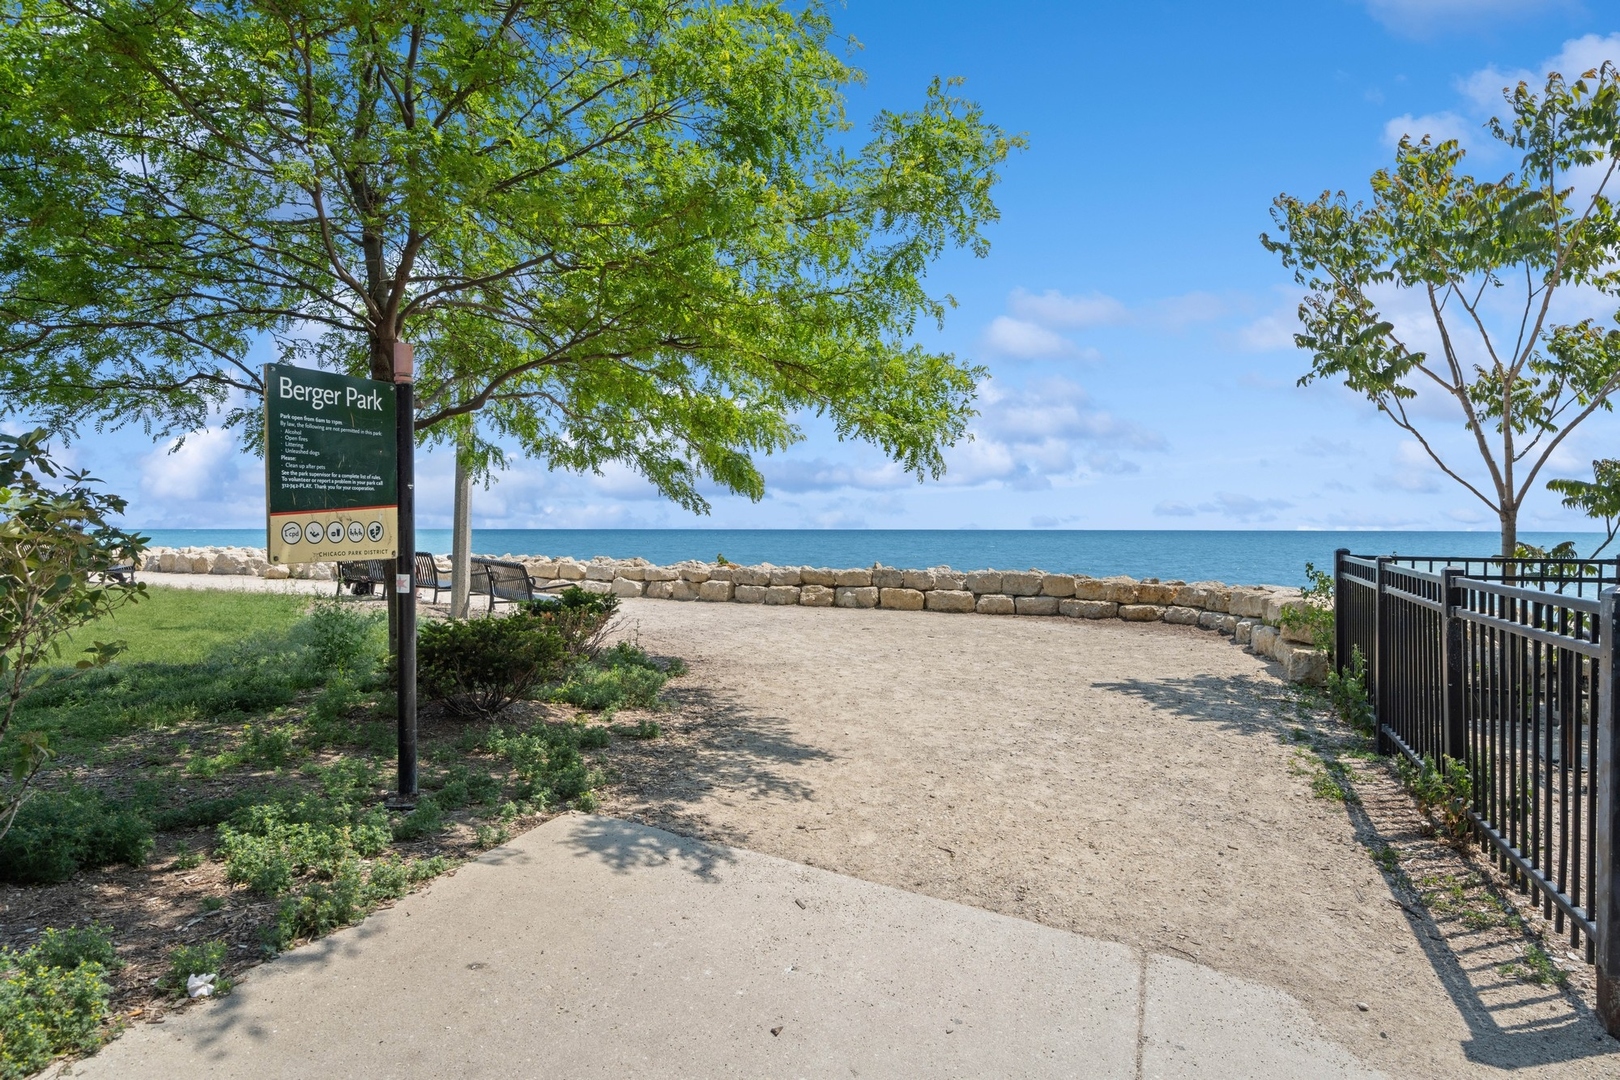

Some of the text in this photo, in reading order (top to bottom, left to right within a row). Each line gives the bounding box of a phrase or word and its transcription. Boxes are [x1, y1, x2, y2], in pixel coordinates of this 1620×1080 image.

[280, 376, 382, 411] Berger Park
[305, 422, 324, 431] following
[289, 531, 299, 540] cpd
